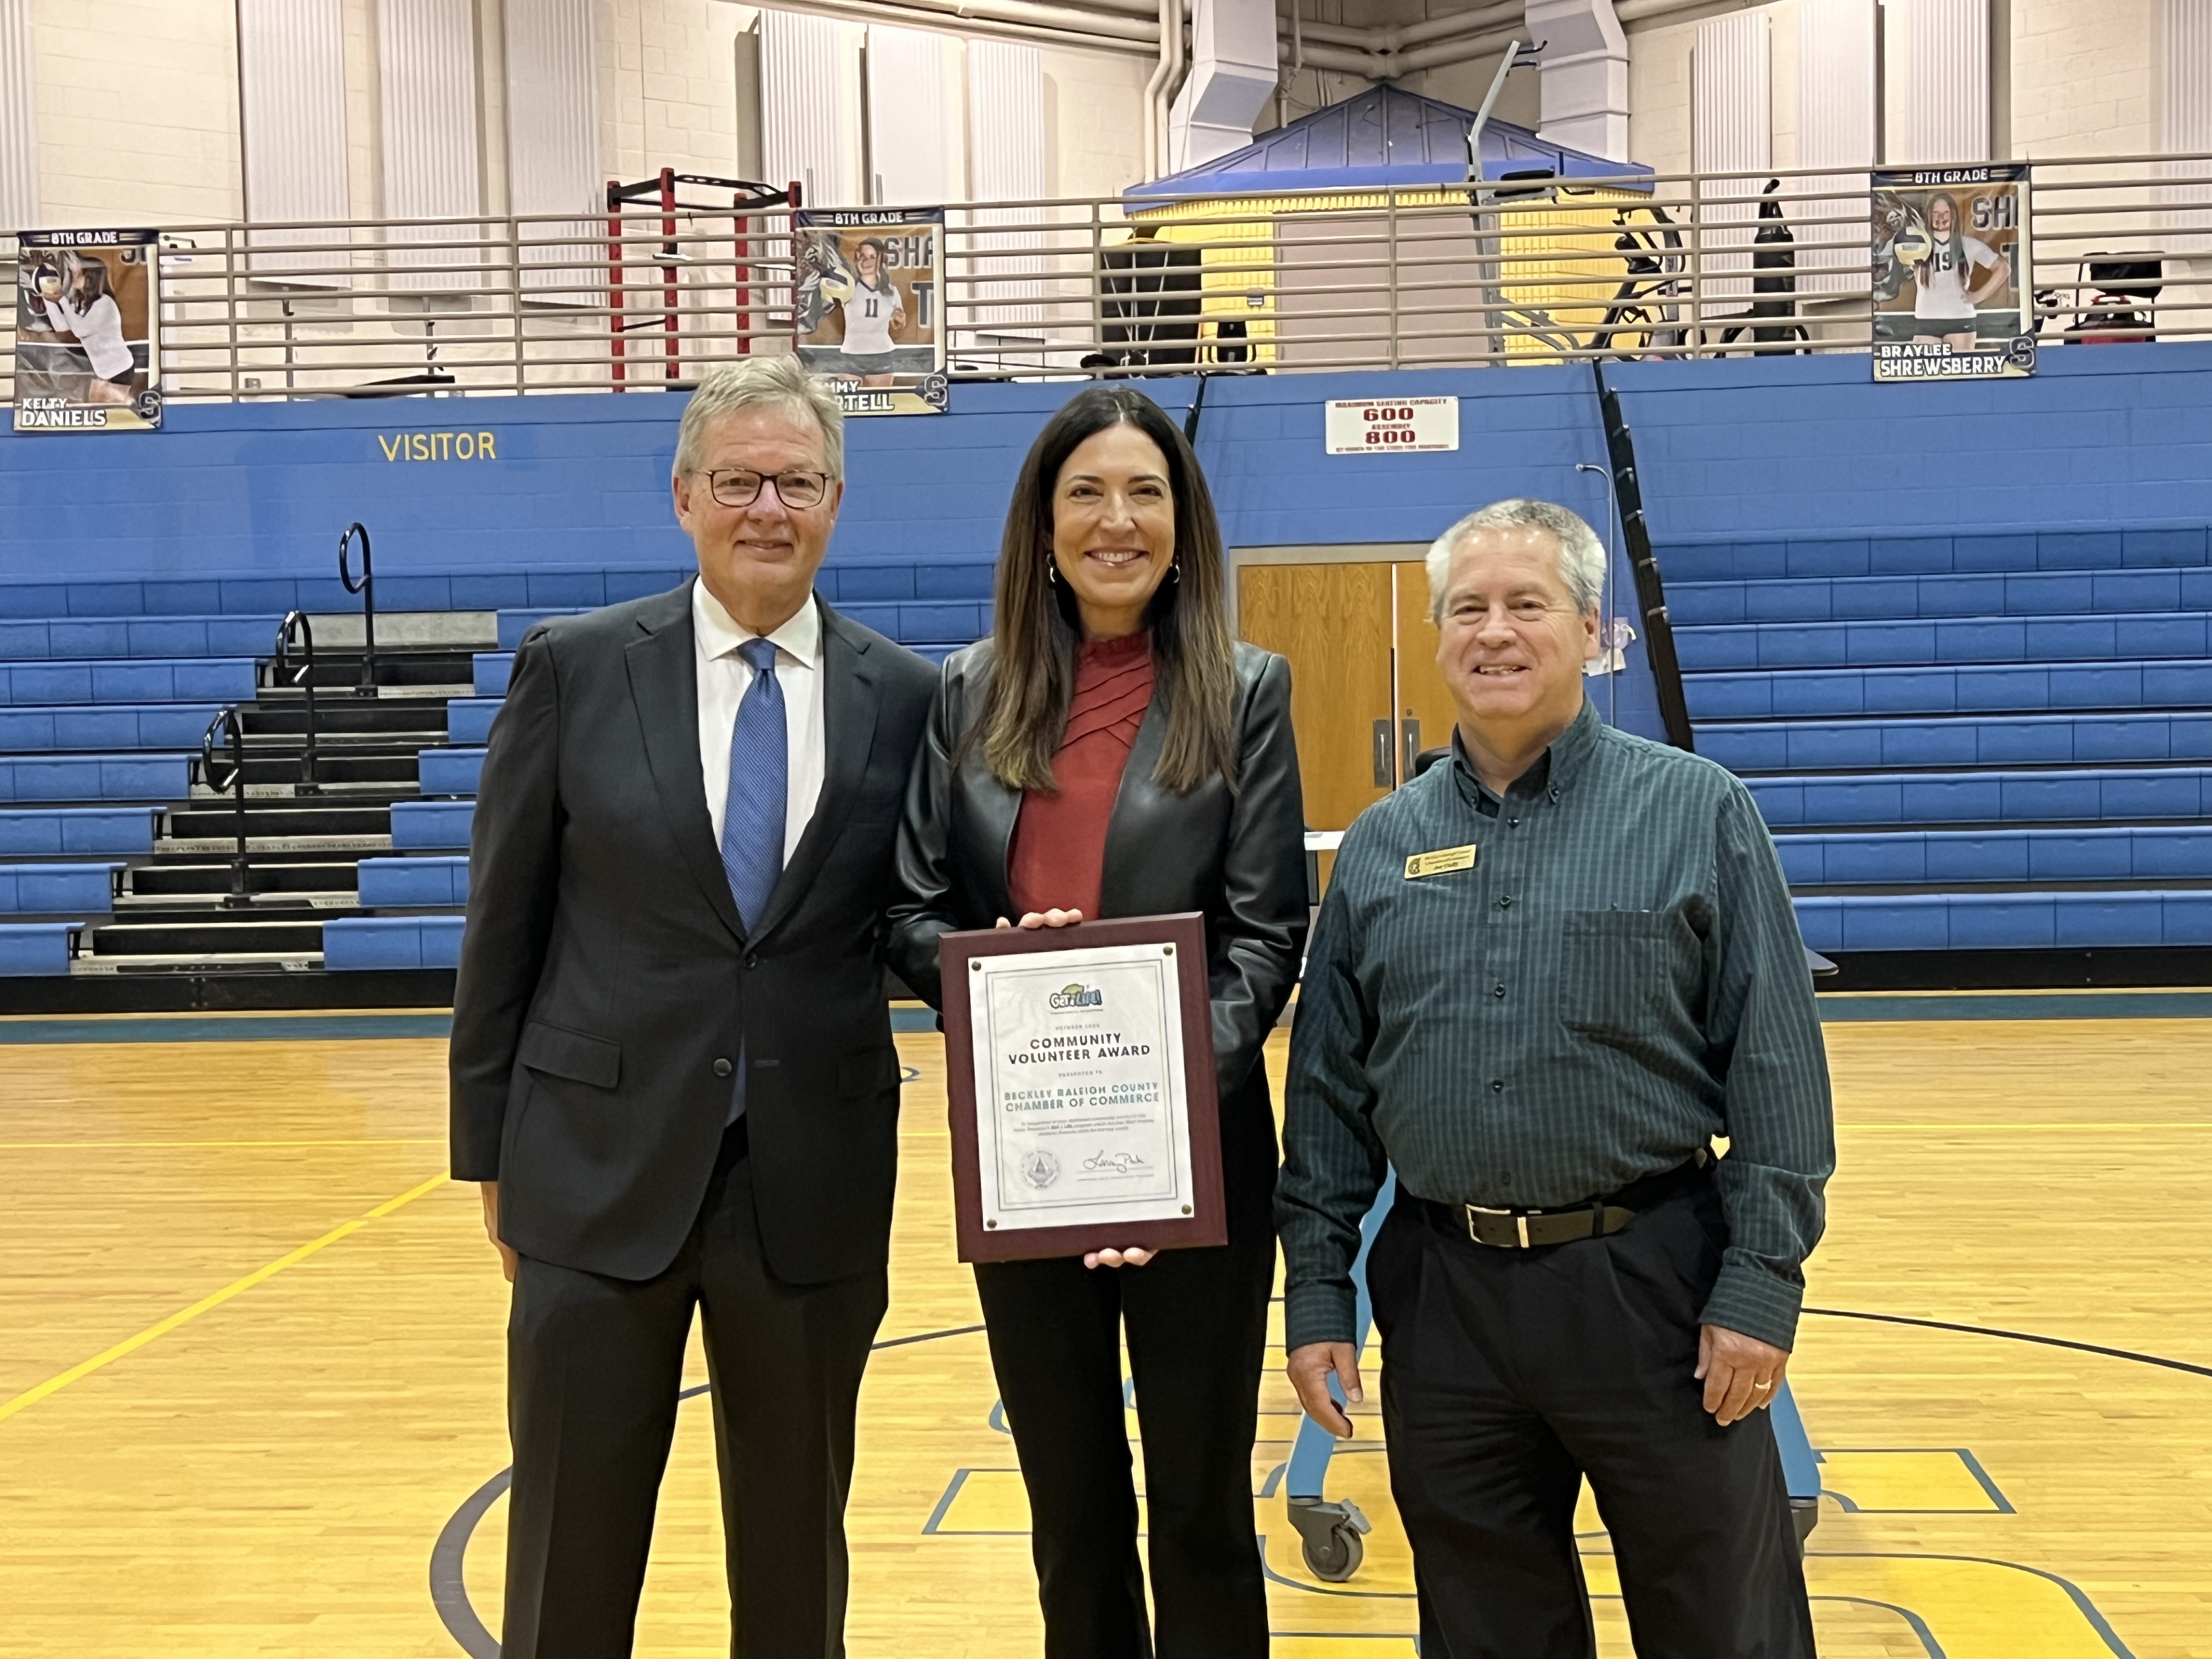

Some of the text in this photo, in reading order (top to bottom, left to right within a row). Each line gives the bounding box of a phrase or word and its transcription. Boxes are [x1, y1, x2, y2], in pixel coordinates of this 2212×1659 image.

[1915, 168, 1988, 183] 8TH GRADE
[835, 211, 903, 224] 8TH GRADE
[51, 232, 117, 244] 8TH GRADE
[865, 298, 878, 318] 11
[1881, 344, 1951, 358] BRAYLEE
[1881, 356, 2006, 376] SHREWSBERRY
[21, 409, 106, 426] DANIELS
[1363, 408, 1414, 421] 600
[1365, 430, 1415, 444] 800
[378, 432, 496, 461] VISITOR
[1030, 1032, 1121, 1049] COMMUNITY
[1008, 1045, 1150, 1065] VOLUNTEER AWARD
[1111, 1082, 1158, 1093] COUNTY
[1006, 1092, 1159, 1112] CHAMBER OF COMMERCE
